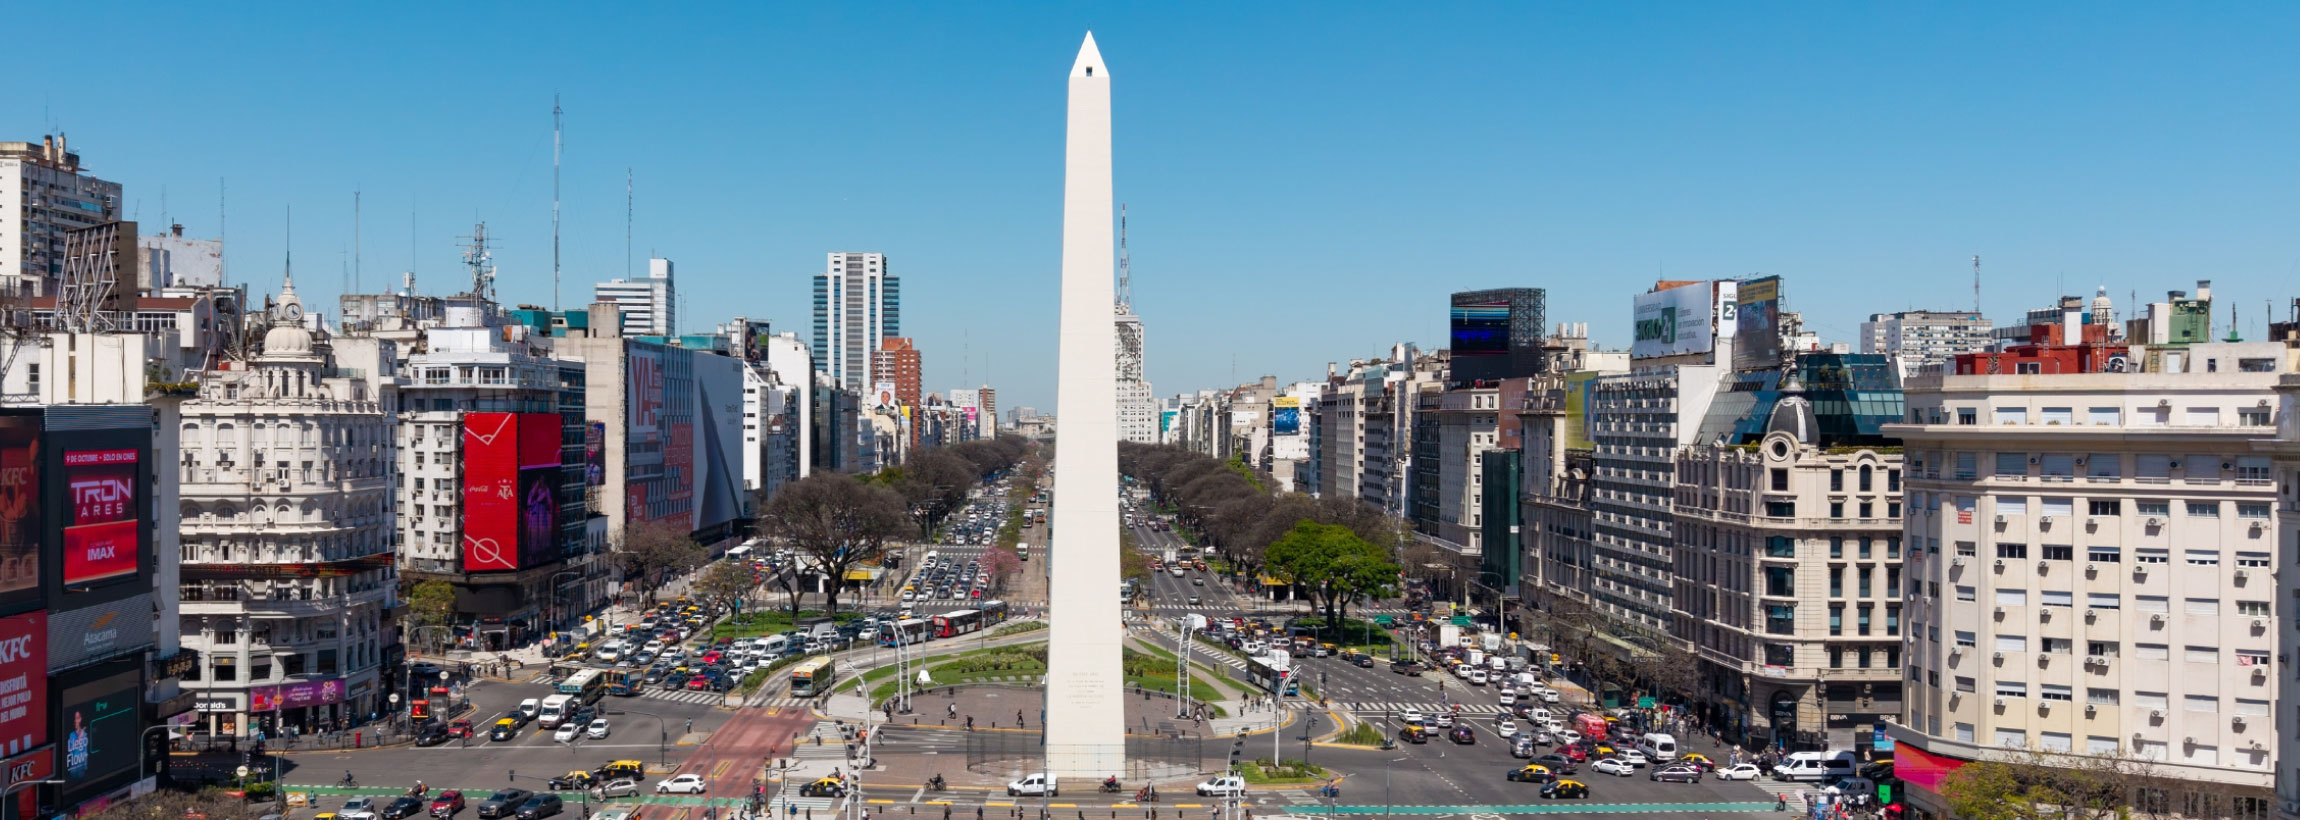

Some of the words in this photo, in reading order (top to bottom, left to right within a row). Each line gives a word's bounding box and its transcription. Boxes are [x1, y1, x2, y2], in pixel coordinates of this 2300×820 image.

[1636, 319, 1661, 341] SIGLO
[71, 455, 77, 463] DE
[78, 454, 98, 462] OCTUBRE
[1, 467, 27, 486] KFC
[71, 478, 131, 504] TRON
[80, 502, 123, 517] ARES
[87, 545, 115, 561] IMAX
[83, 627, 117, 646] Atacama
[0, 634, 31, 664] KFC
[10, 760, 35, 783] KFC
